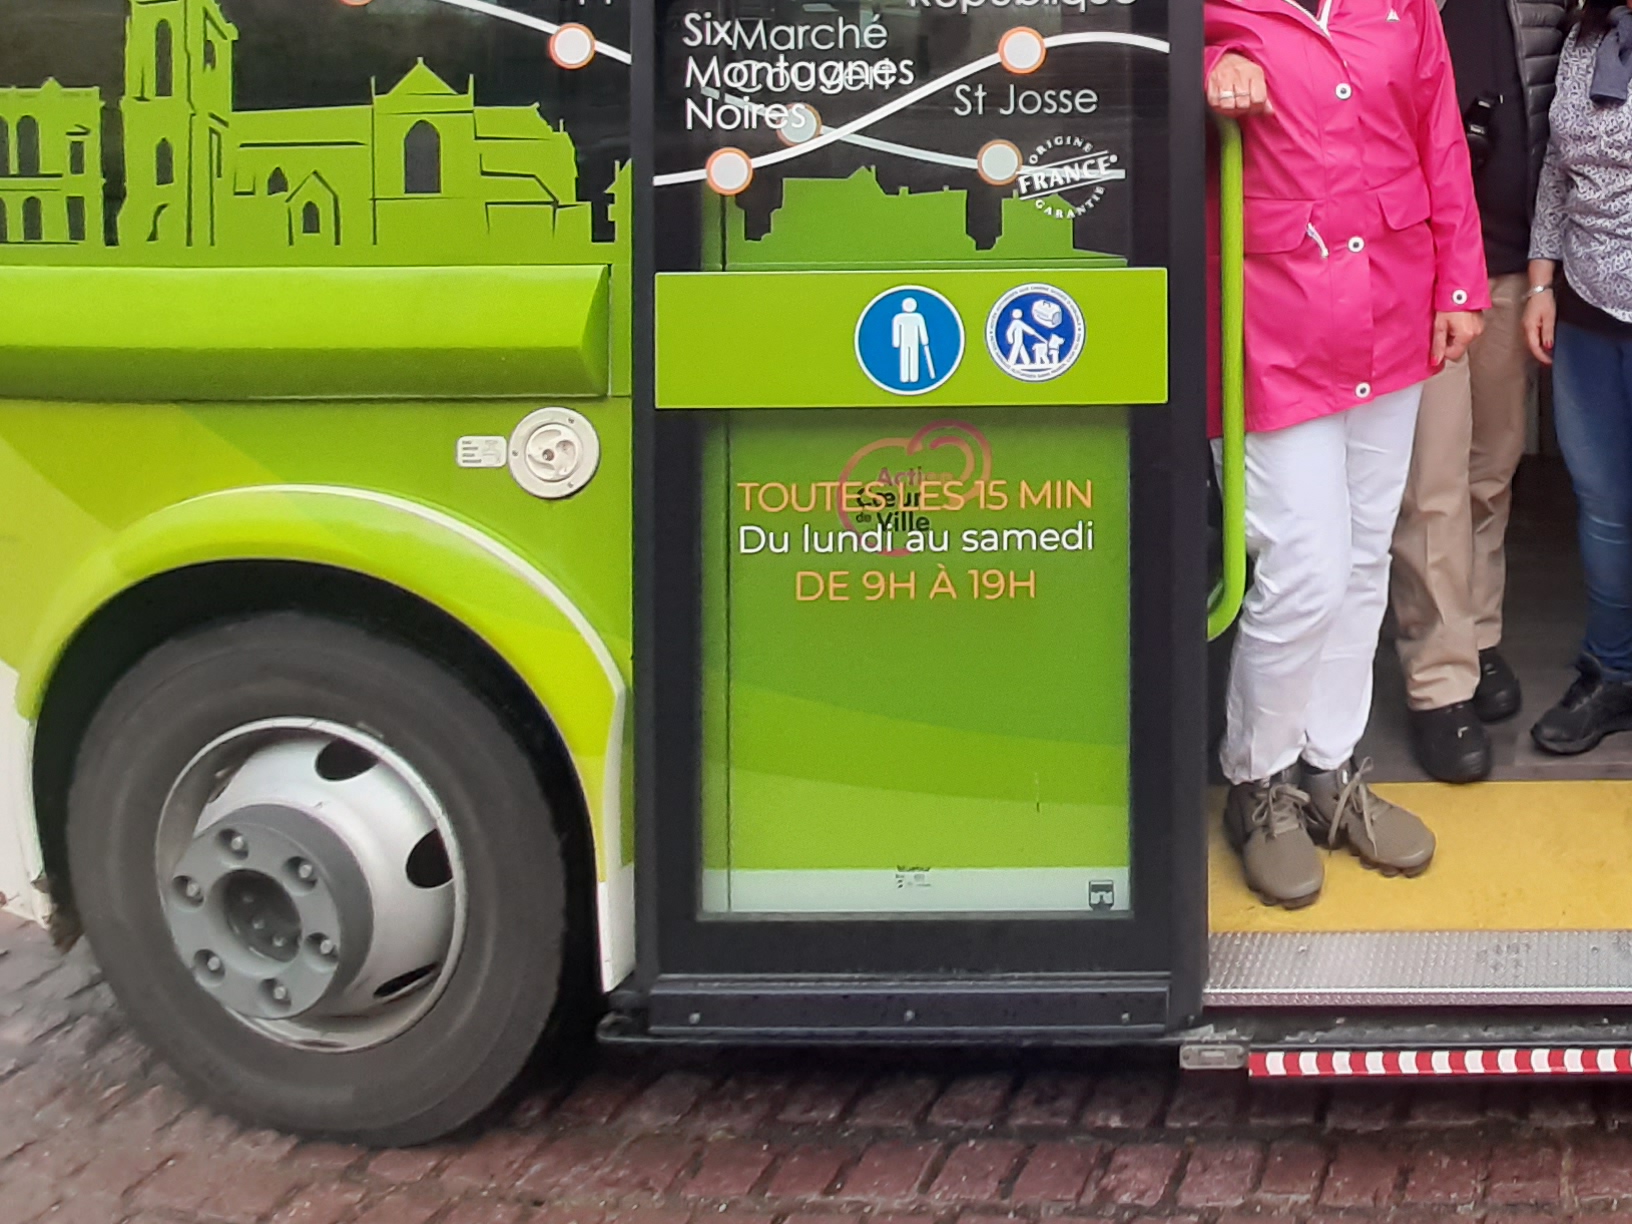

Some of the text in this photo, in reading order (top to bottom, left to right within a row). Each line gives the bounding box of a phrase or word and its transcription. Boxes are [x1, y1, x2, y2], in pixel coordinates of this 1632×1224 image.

[682, 12, 732, 47] Six
[731, 13, 889, 51] Marché
[684, 53, 915, 95] Montagnes
[685, 95, 808, 131] Noires
[953, 84, 1099, 117] St Josse
[1029, 136, 1094, 165] ORIGINE
[1035, 186, 1106, 220] GARANTIE
[736, 479, 1092, 513] TOUTES LES 15 MIN
[738, 520, 1095, 554] Du lundi au samedi
[795, 562, 1037, 602] DE 9H À 19H
